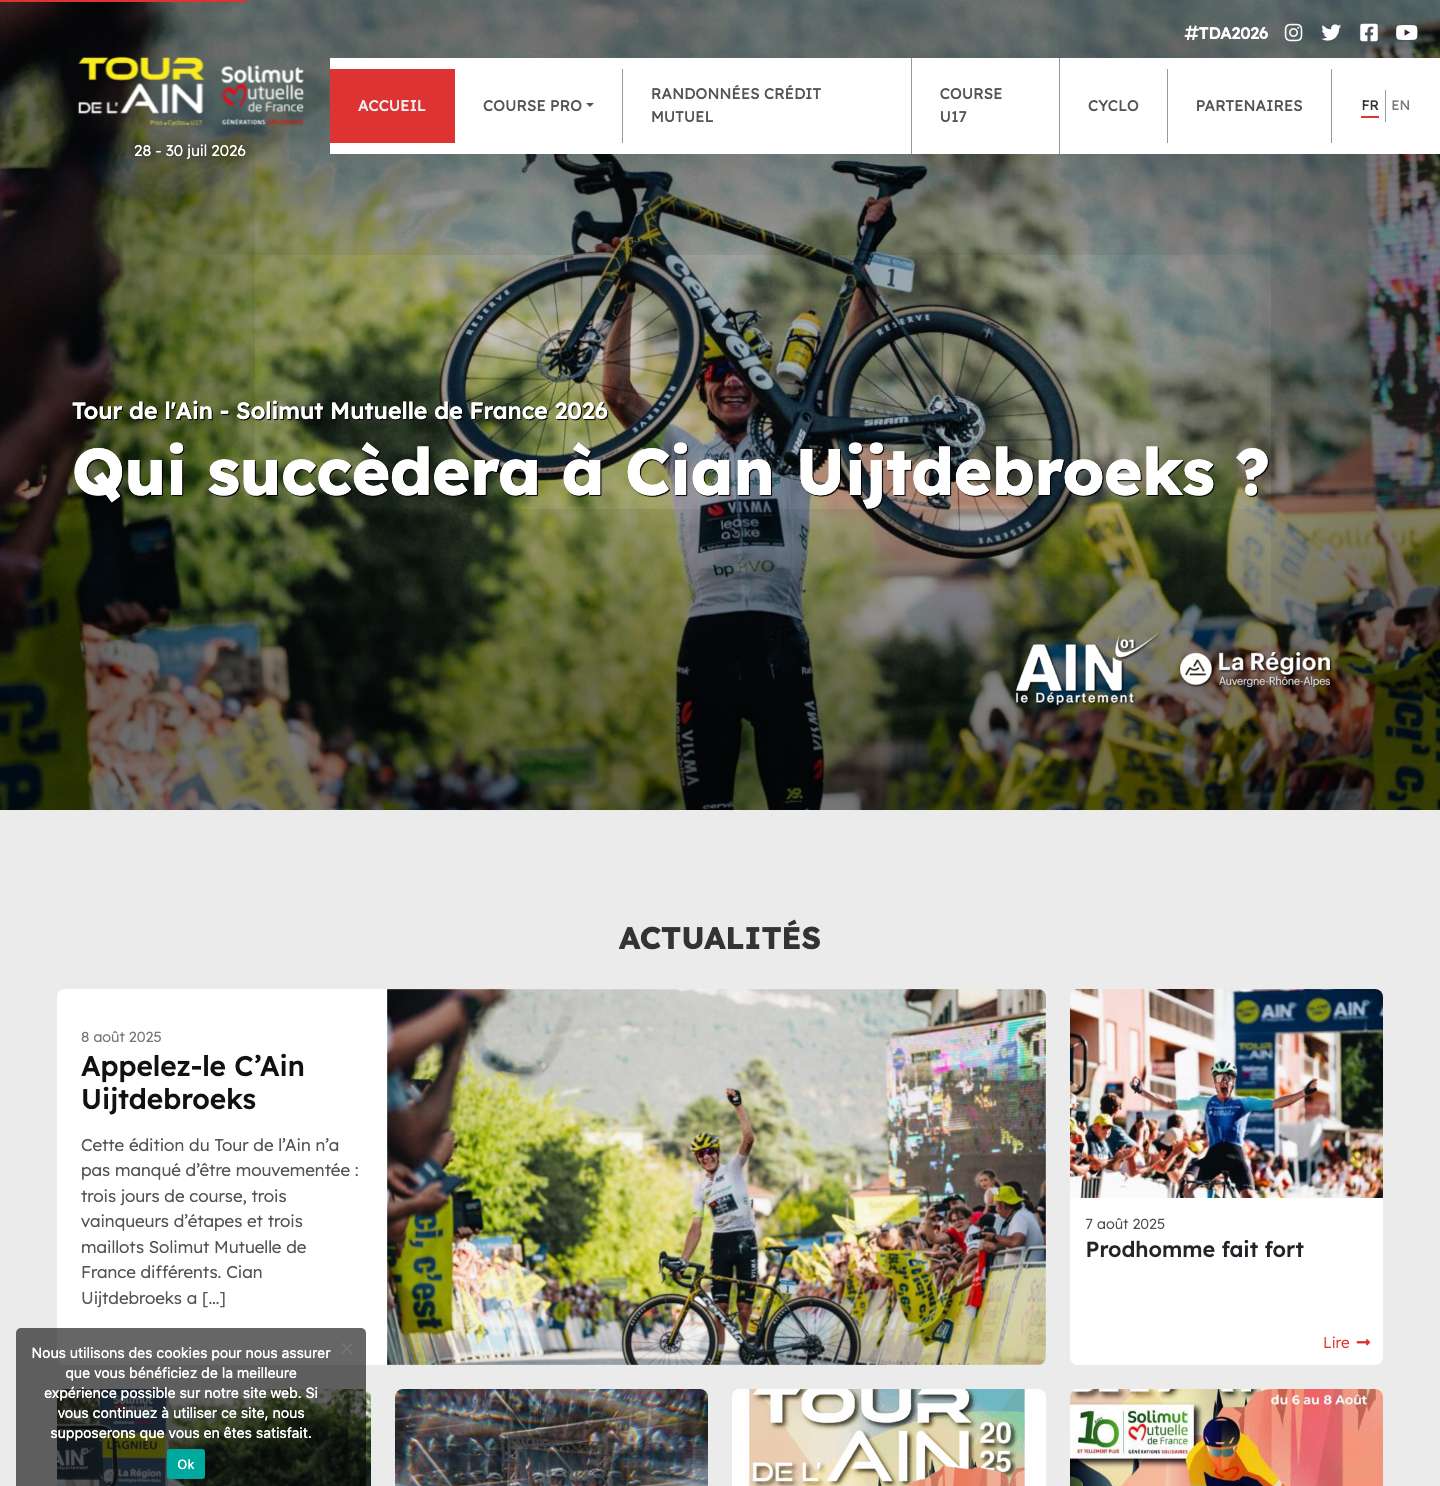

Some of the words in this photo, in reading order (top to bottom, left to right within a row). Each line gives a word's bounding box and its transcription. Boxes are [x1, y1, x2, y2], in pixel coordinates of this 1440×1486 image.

[1185, 26, 1268, 40] #TDA2026
[78, 55, 205, 81] TOUR
[220, 65, 305, 86] Solimut
[120, 82, 205, 115] AIN
[652, 85, 759, 99] RANDONNÉES
[765, 85, 821, 99] CRÉDIT
[940, 88, 1002, 99] COURSE
[358, 99, 426, 112] ACCUEIL
[483, 100, 545, 111] COURSE
[551, 100, 582, 111] PRO
[1088, 100, 1138, 111] CYCLO
[1197, 100, 1302, 111] PARTENAIRES
[652, 111, 713, 122] MUTUEL
[941, 111, 966, 122] U17
[135, 145, 151, 156] 28
[166, 145, 183, 156] 30
[187, 144, 206, 159] juil
[212, 145, 245, 156] 2026
[886, 268, 896, 287] 1
[465, 288, 511, 336] RESERVE
[73, 402, 122, 419] Tour
[130, 402, 157, 419] de
[237, 401, 323, 419] Solimut
[332, 401, 427, 419] Mutuelle
[435, 401, 462, 419] de
[471, 402, 547, 419] France
[556, 401, 607, 419] 2026
[75, 443, 183, 502] Qui
[209, 443, 537, 496] succèdera
[564, 442, 600, 495] à
[628, 442, 771, 496] Cian
[798, 443, 1213, 505] Uijtdebroeks
[1236, 448, 1268, 496] ?
[1119, 638, 1135, 650] 01
[1015, 643, 1124, 693] AIN
[1219, 653, 1243, 670] La
[1251, 652, 1330, 674] Région
[1218, 675, 1332, 688] Auvergne-Rhône-Alpes
[1016, 690, 1028, 702] le
[1036, 690, 1133, 704] Département
[619, 920, 820, 949] ACTUALITÉS
[1261, 1002, 1292, 1019] AIN
[94, 1031, 125, 1042] août
[81, 1055, 225, 1082] Appelez-le
[235, 1054, 303, 1076] C’Ain
[83, 1087, 255, 1115] Uijtdebroeks
[1087, 1241, 1215, 1257] Prodhomme
[1222, 1240, 1258, 1257] fait
[1265, 1241, 1304, 1257] fort
[1324, 1336, 1349, 1348] Lire
[760, 1390, 972, 1425] TOUR
[1127, 1410, 1189, 1424] Solimut
[979, 1421, 1012, 1445] 20
[979, 1450, 1012, 1473] 25
